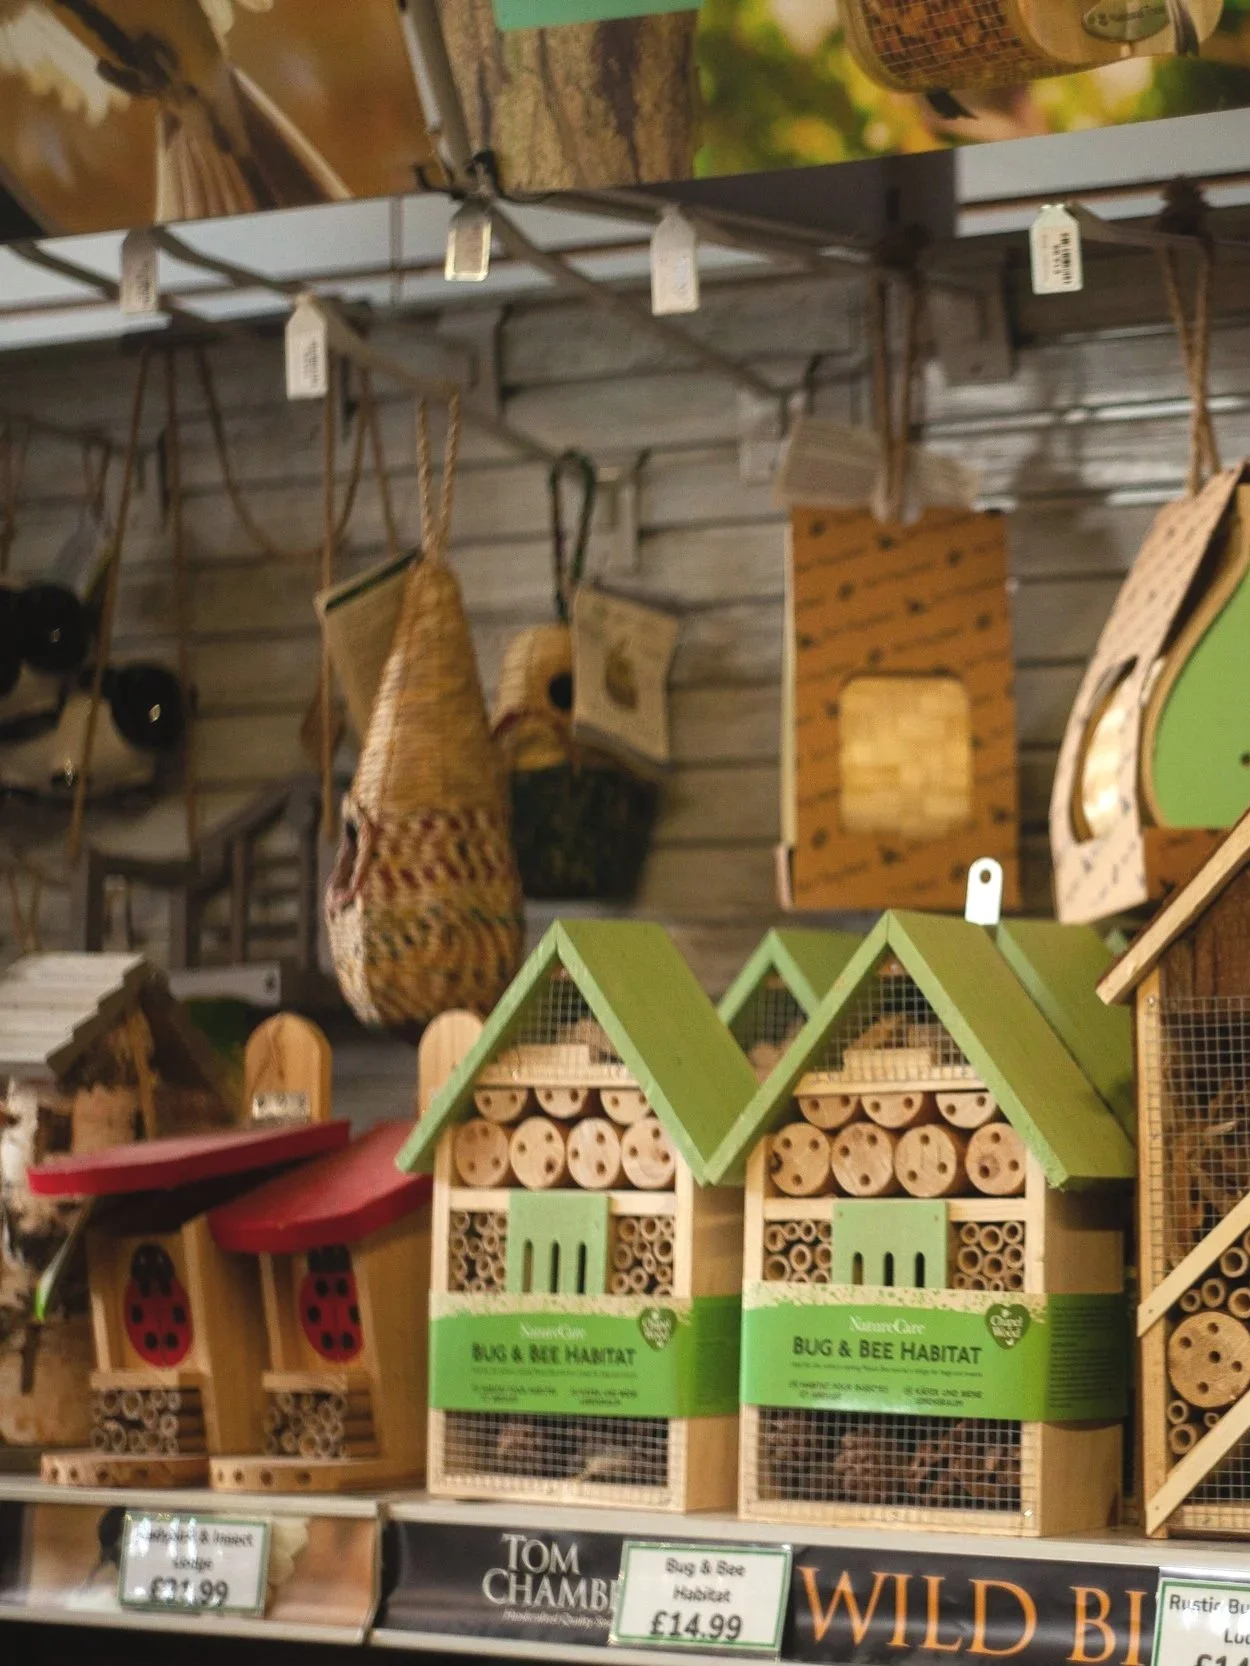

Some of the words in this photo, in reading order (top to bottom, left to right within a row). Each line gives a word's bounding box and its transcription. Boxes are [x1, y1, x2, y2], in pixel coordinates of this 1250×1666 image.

[471, 1342, 507, 1364] BUG
[511, 1345, 523, 1364] &
[529, 1344, 560, 1366] BEE
[565, 1346, 637, 1367] HABITAT
[792, 1336, 833, 1357] BUG
[838, 1338, 852, 1359] &
[859, 1339, 894, 1361] BEE
[900, 1341, 983, 1365] HABITAT
[501, 1533, 581, 1575] TOM
[665, 1557, 696, 1578] Bug
[700, 1559, 710, 1575] &
[716, 1559, 746, 1577] Bee
[673, 1584, 731, 1604] Habitat
[650, 1609, 743, 1640] £14.99
[796, 1565, 1038, 1656] WILD
[1065, 1586, 1147, 1666] BI
